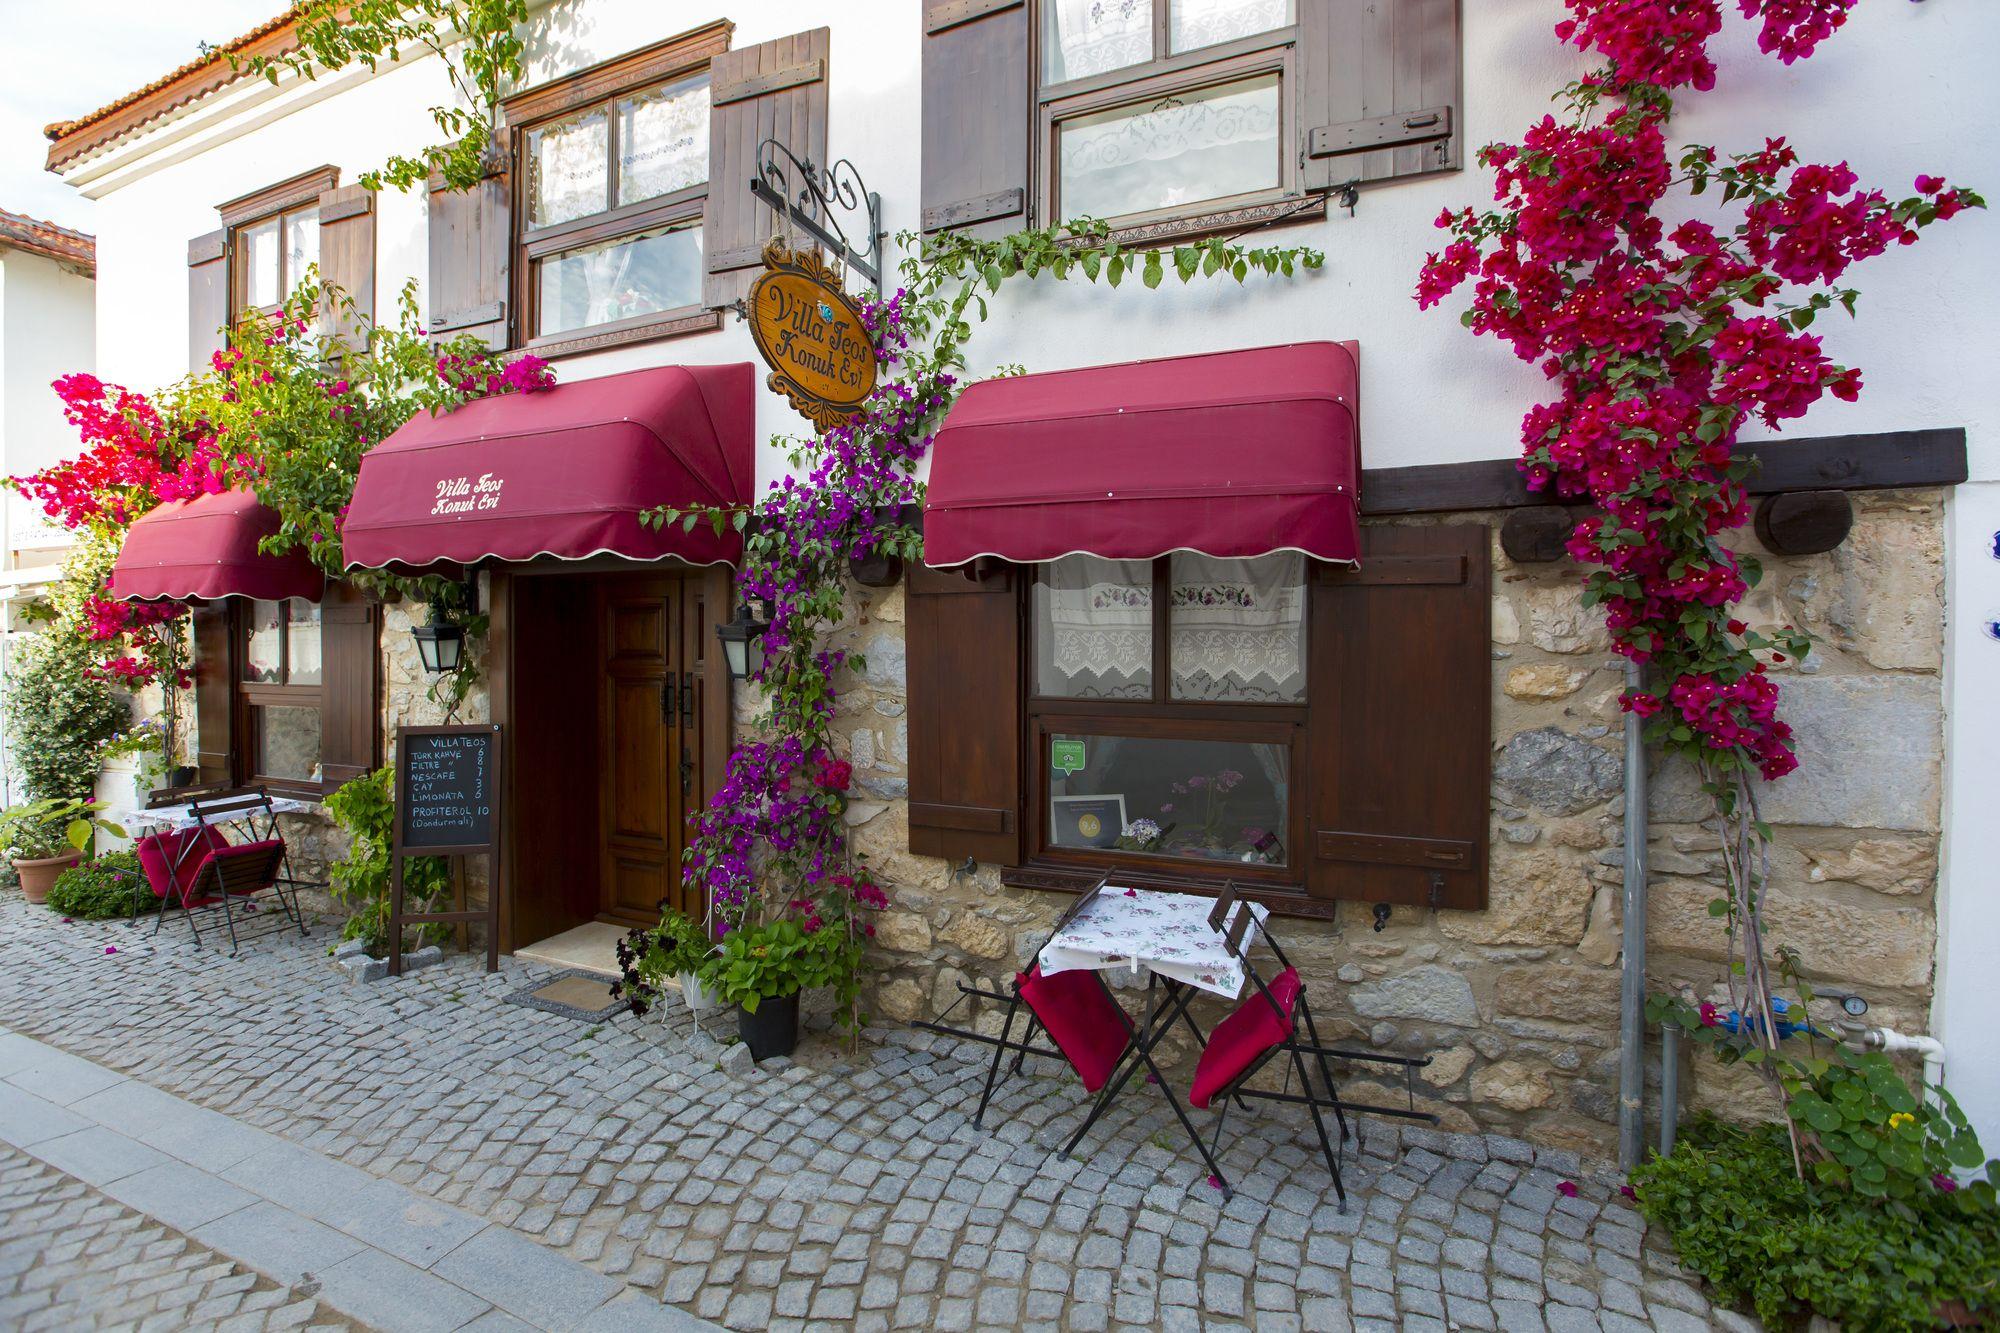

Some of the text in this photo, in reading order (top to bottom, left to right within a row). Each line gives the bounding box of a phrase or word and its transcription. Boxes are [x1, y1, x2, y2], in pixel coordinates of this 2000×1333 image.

[770, 285, 867, 363] Villa Teos
[776, 329, 863, 389] Konuk Evi
[436, 473, 504, 498] Villa Teos
[431, 493, 500, 515] Konuk Evi
[460, 737, 486, 747] TEOS
[478, 748, 484, 756] 6
[477, 757, 483, 765] 8
[411, 772, 456, 782] NESCAFE
[475, 778, 482, 788] 3
[474, 788, 482, 799] 6
[477, 806, 490, 815] 10
